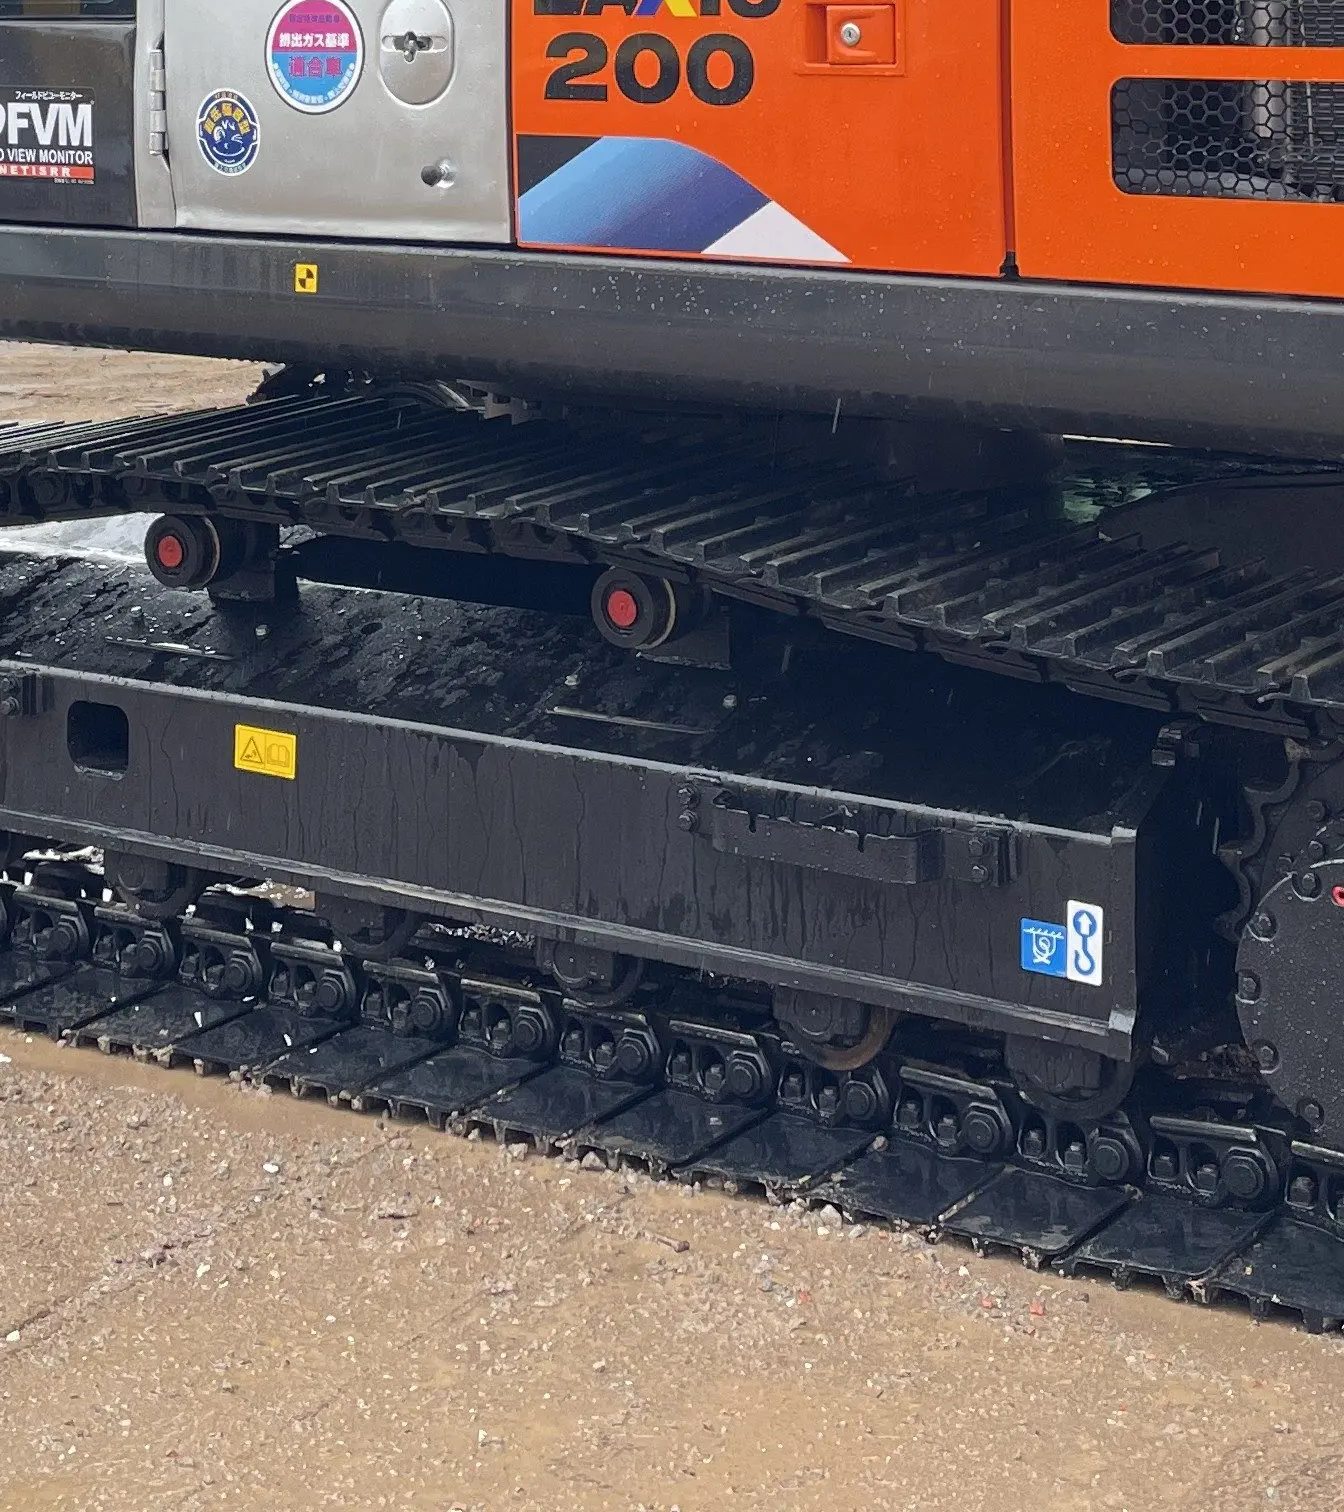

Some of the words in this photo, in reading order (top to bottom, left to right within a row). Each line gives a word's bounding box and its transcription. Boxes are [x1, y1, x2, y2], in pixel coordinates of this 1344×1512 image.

[544, 31, 755, 107] 200
[7, 148, 36, 162] VIEW
[39, 149, 94, 165] MONITOR
